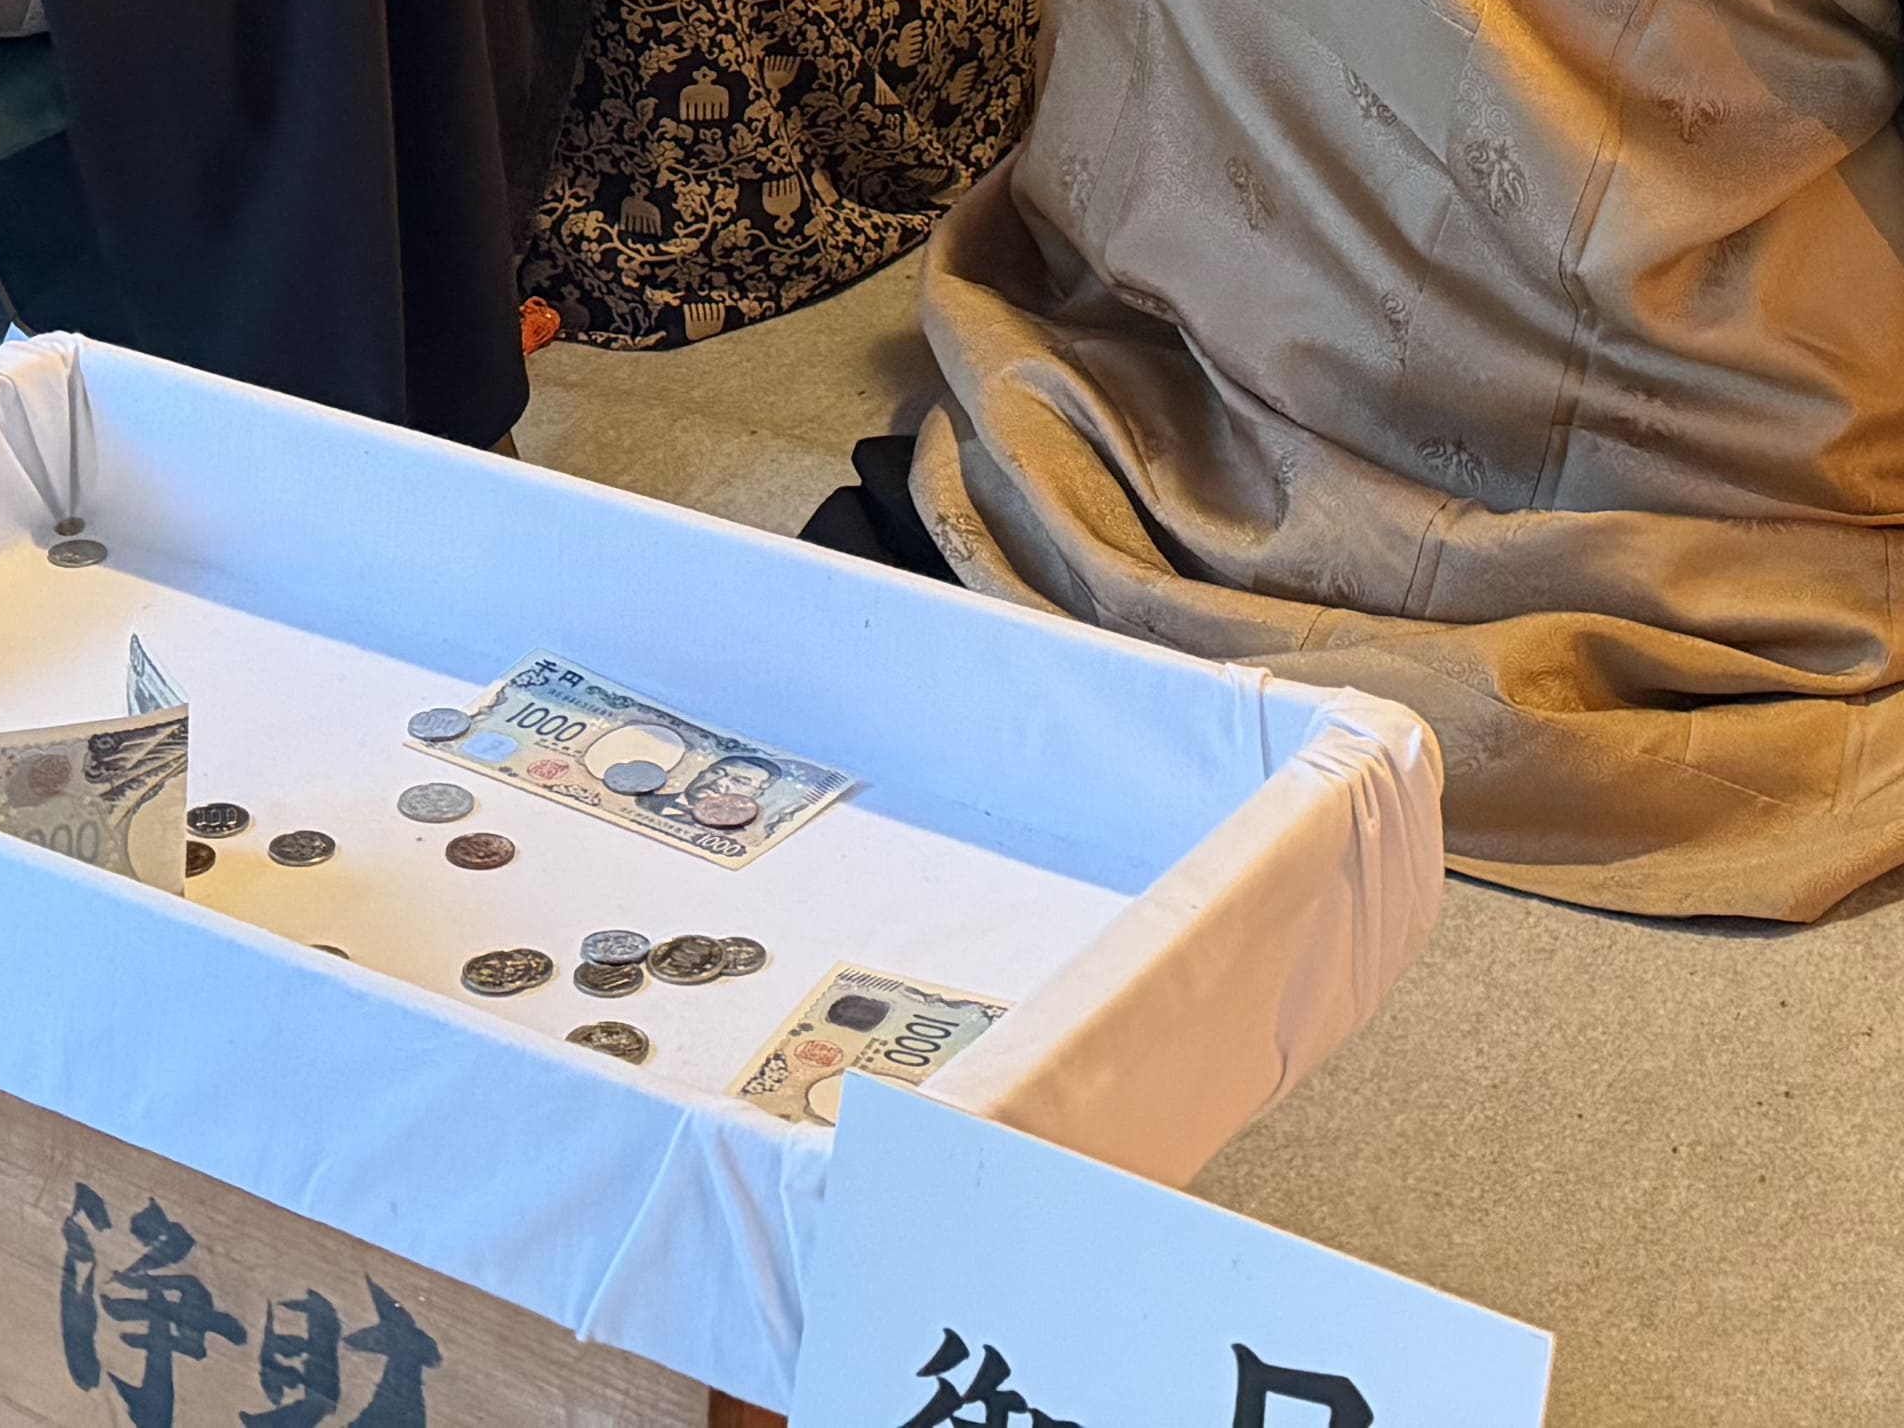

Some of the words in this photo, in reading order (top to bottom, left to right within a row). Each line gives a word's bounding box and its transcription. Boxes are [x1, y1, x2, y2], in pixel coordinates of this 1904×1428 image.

[534, 658, 585, 689] 千円
[505, 702, 588, 743] 1000
[196, 807, 238, 827] 100
[696, 833, 742, 856] 1000
[884, 1013, 960, 1067] 1000
[60, 1181, 443, 1428] 浄財
